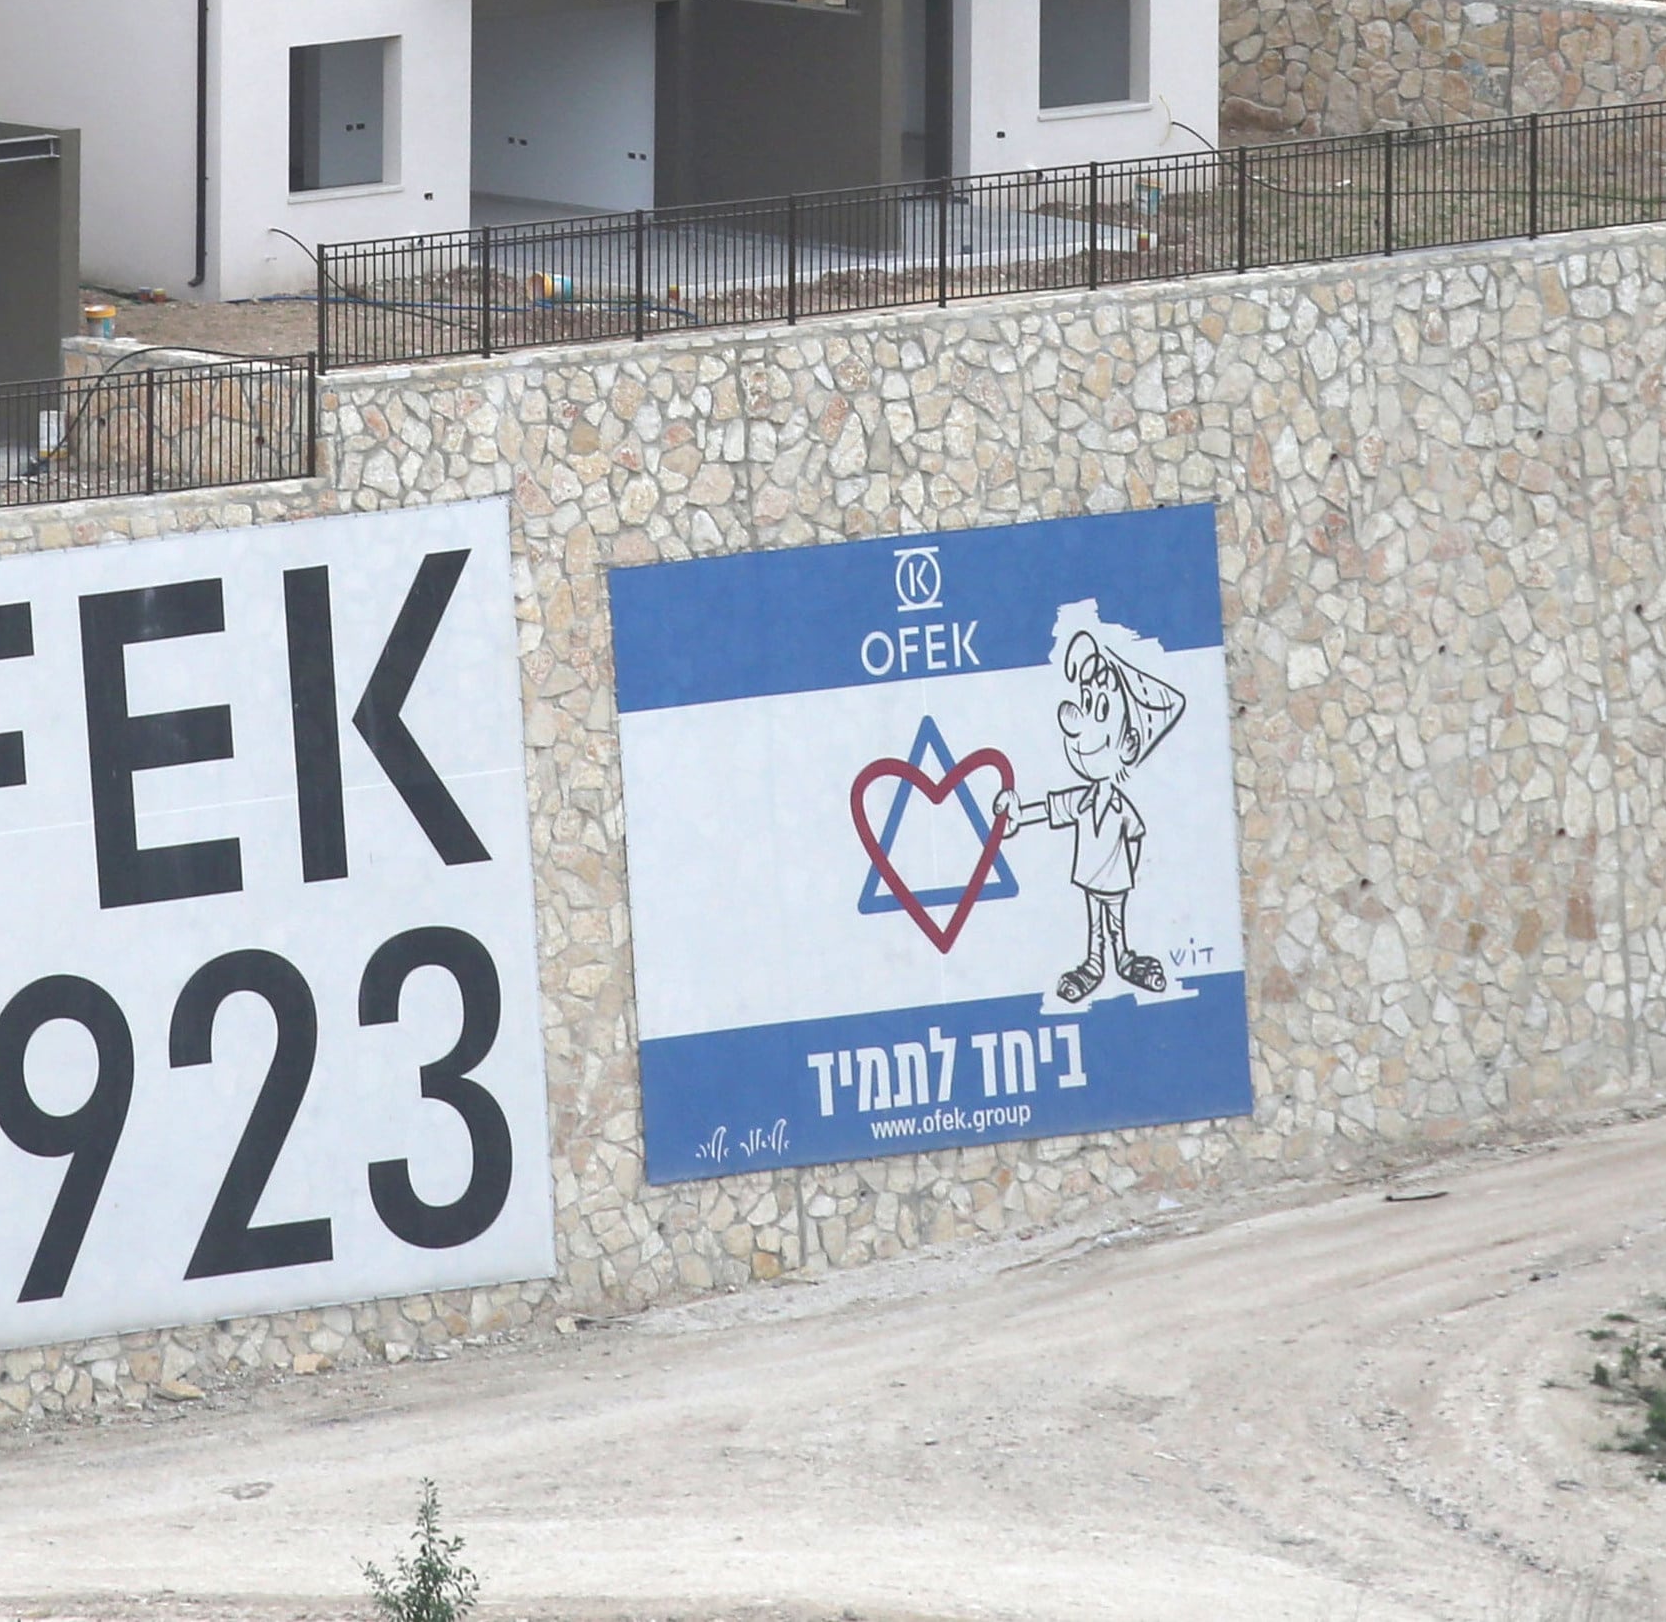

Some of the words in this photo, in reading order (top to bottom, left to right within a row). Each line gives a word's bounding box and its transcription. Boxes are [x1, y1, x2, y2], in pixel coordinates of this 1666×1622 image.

[861, 620, 981, 677] OFEK
[807, 1027, 957, 1117] לתמיד
[971, 1024, 1087, 1097] ביחד
[870, 1104, 1032, 1139] www.ofek.group
